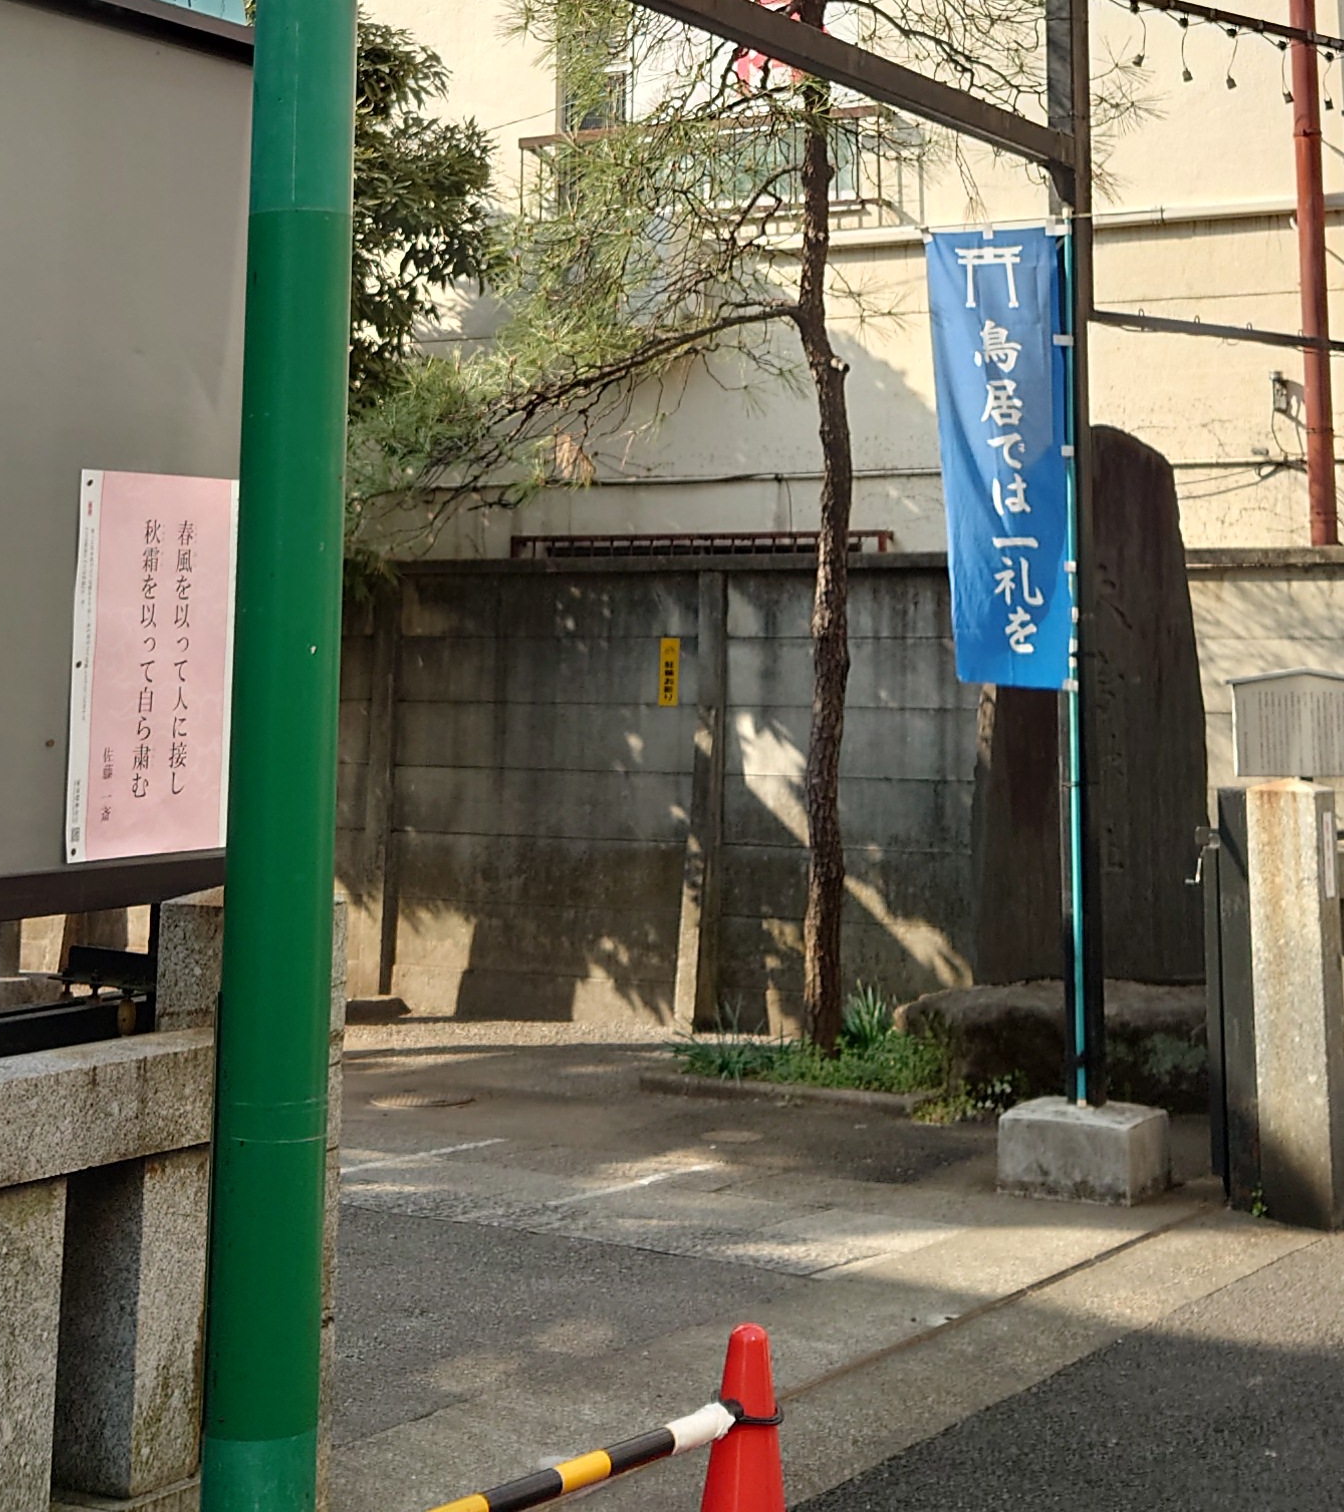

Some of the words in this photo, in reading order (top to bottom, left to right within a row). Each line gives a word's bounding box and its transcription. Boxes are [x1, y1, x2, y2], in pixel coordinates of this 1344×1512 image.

[973, 319, 1045, 656] 鳥居では一礼を
[167, 519, 196, 796] 春風を以って人に接し
